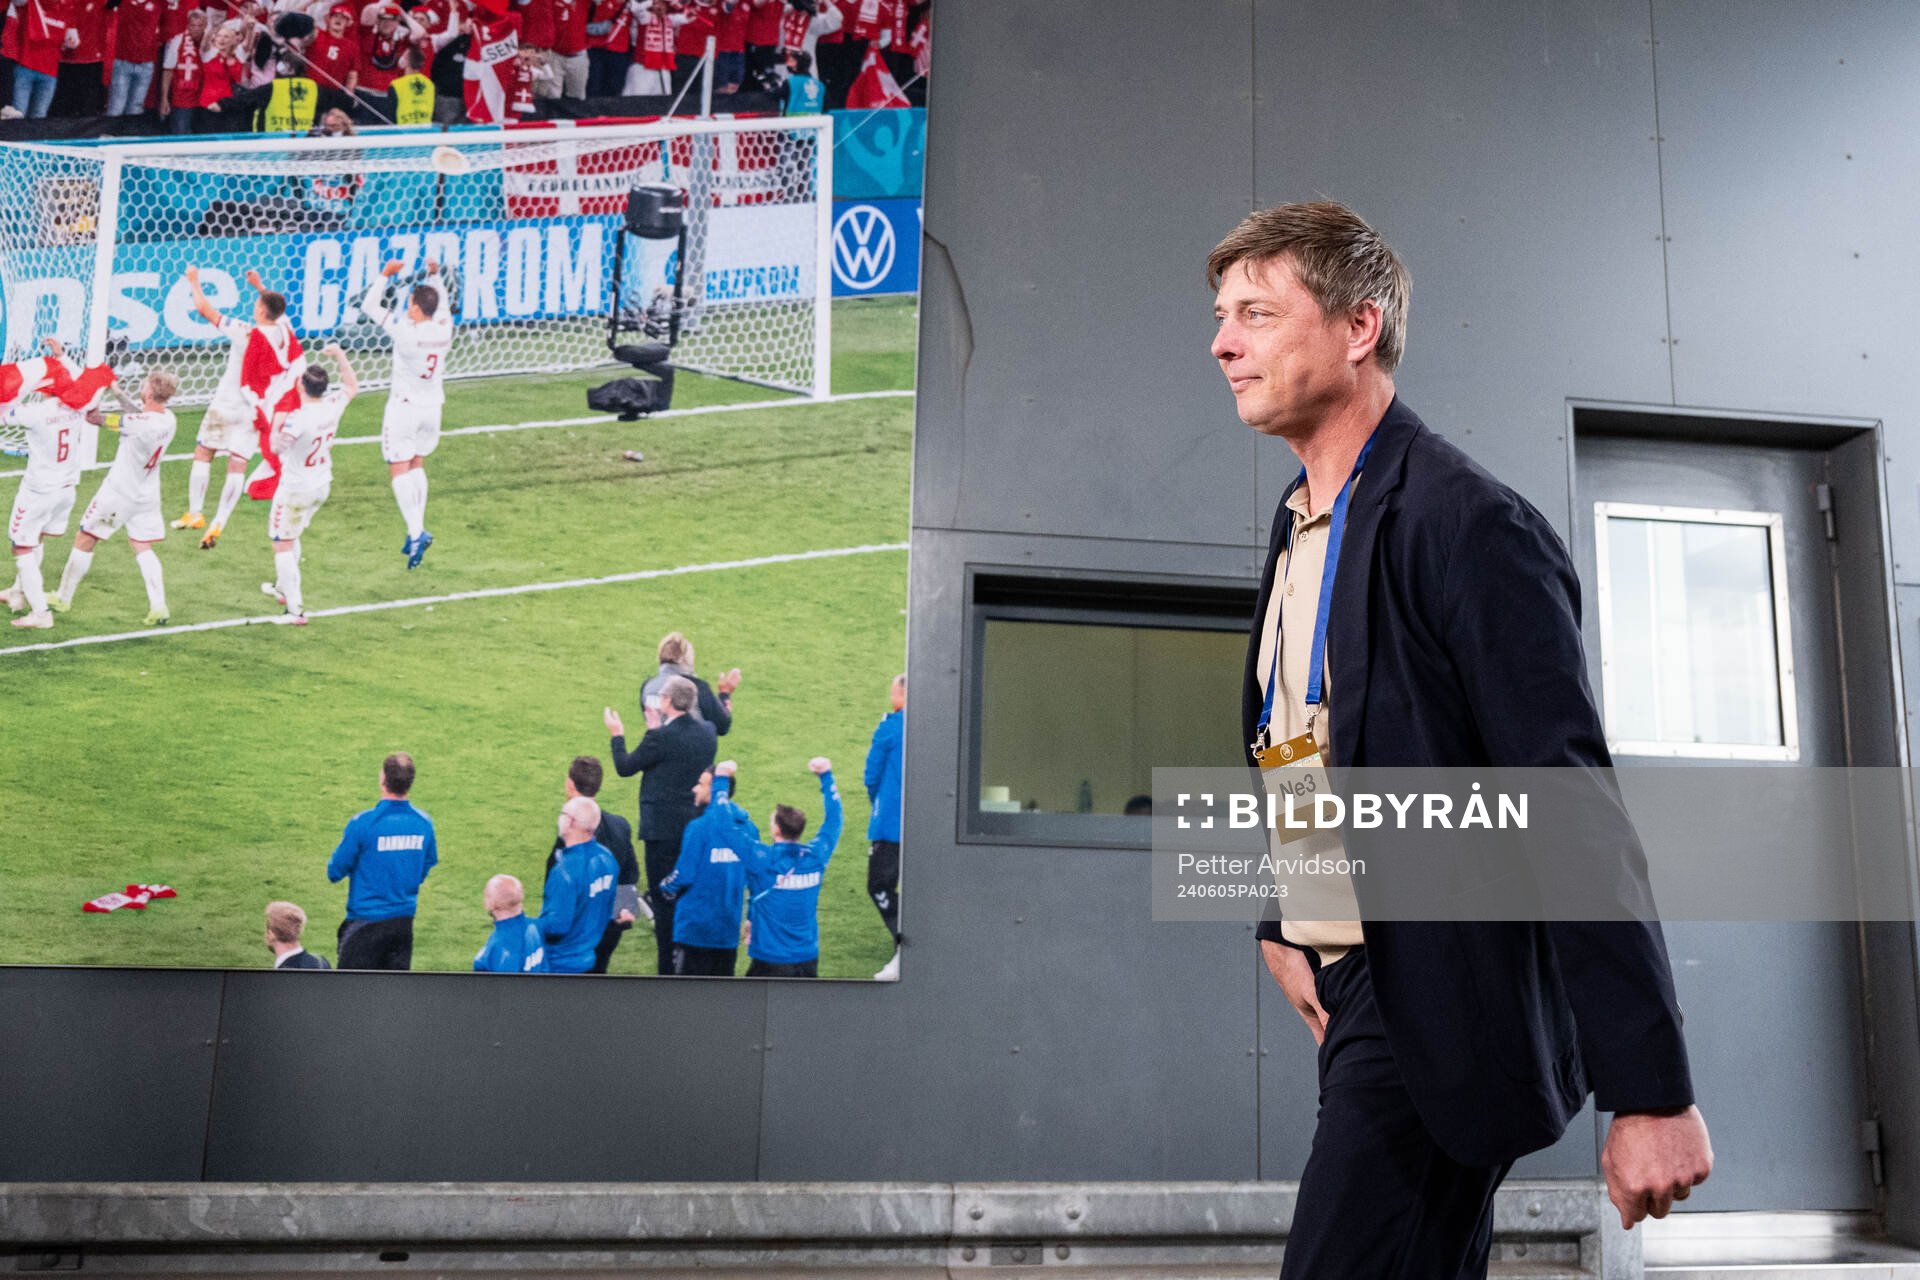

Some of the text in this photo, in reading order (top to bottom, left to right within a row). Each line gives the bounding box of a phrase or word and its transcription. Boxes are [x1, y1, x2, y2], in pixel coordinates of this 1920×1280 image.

[420, 354, 438, 380] 3
[57, 428, 70, 462] 6
[144, 445, 162, 474] 4
[1279, 773, 1316, 803] Ne3
